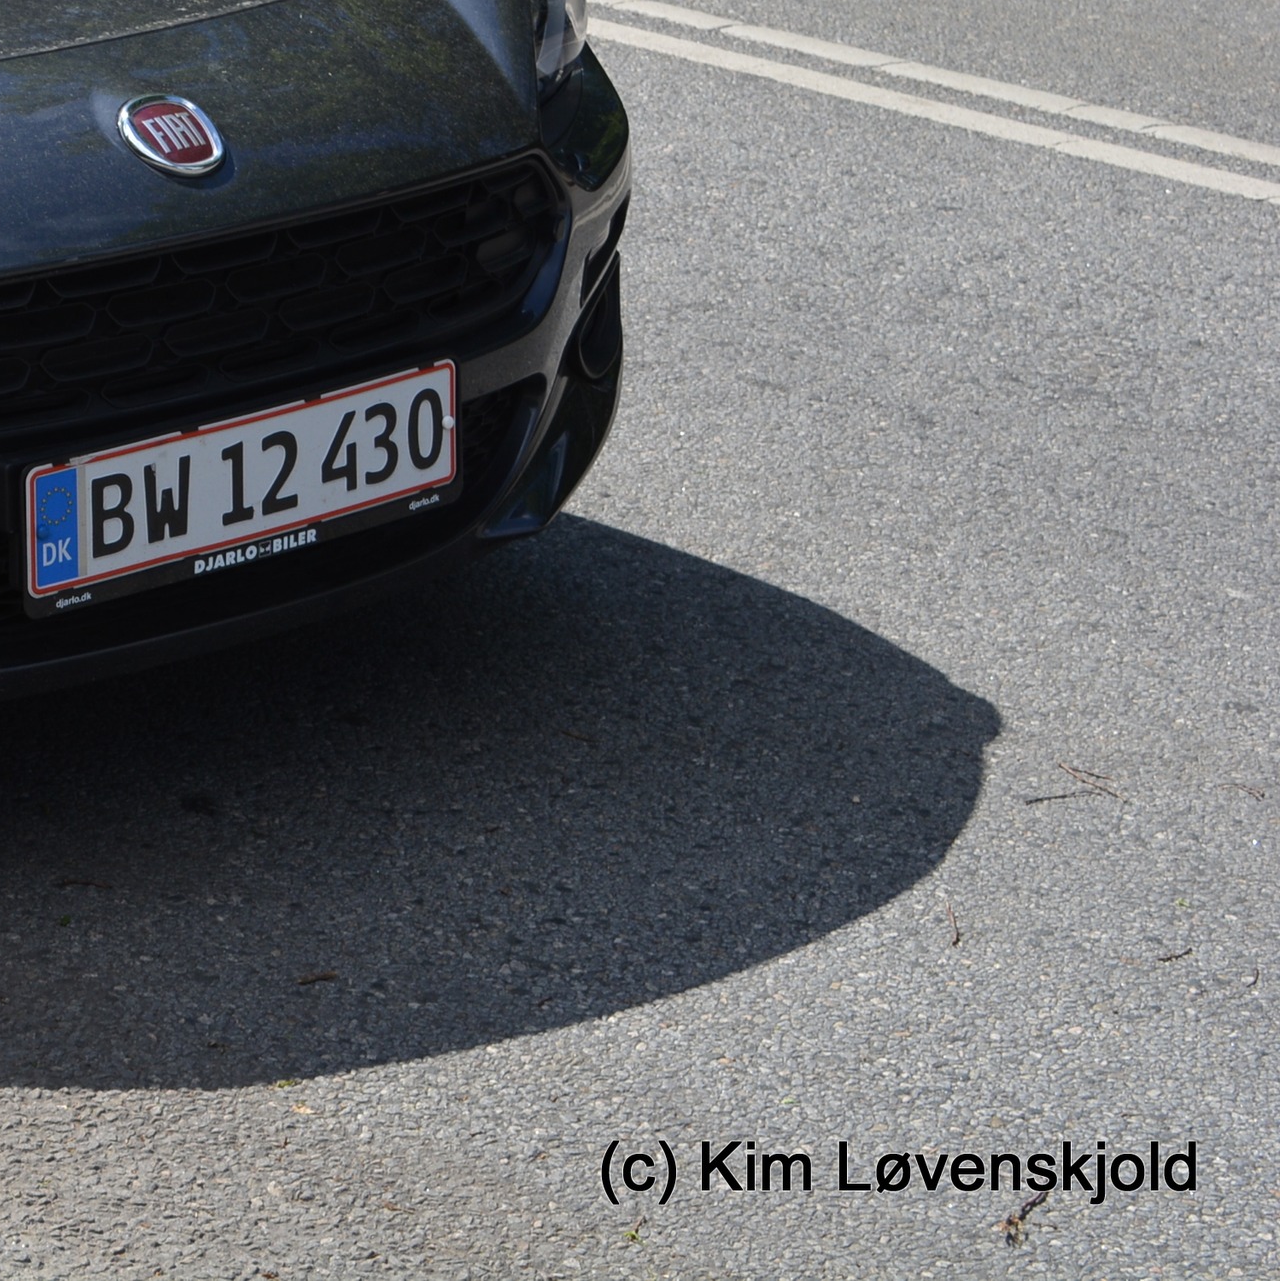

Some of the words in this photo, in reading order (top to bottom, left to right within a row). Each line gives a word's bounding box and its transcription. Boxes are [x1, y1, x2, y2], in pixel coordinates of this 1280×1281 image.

[141, 111, 207, 154] FIAT
[91, 454, 191, 559] BW
[221, 430, 299, 527] 12
[321, 388, 444, 492] 430
[408, 493, 440, 511] djarlo.dk
[42, 537, 72, 567] DK
[194, 545, 258, 575] DJARLO
[272, 528, 317, 554] BILER
[55, 591, 92, 609] djarlo.dk
